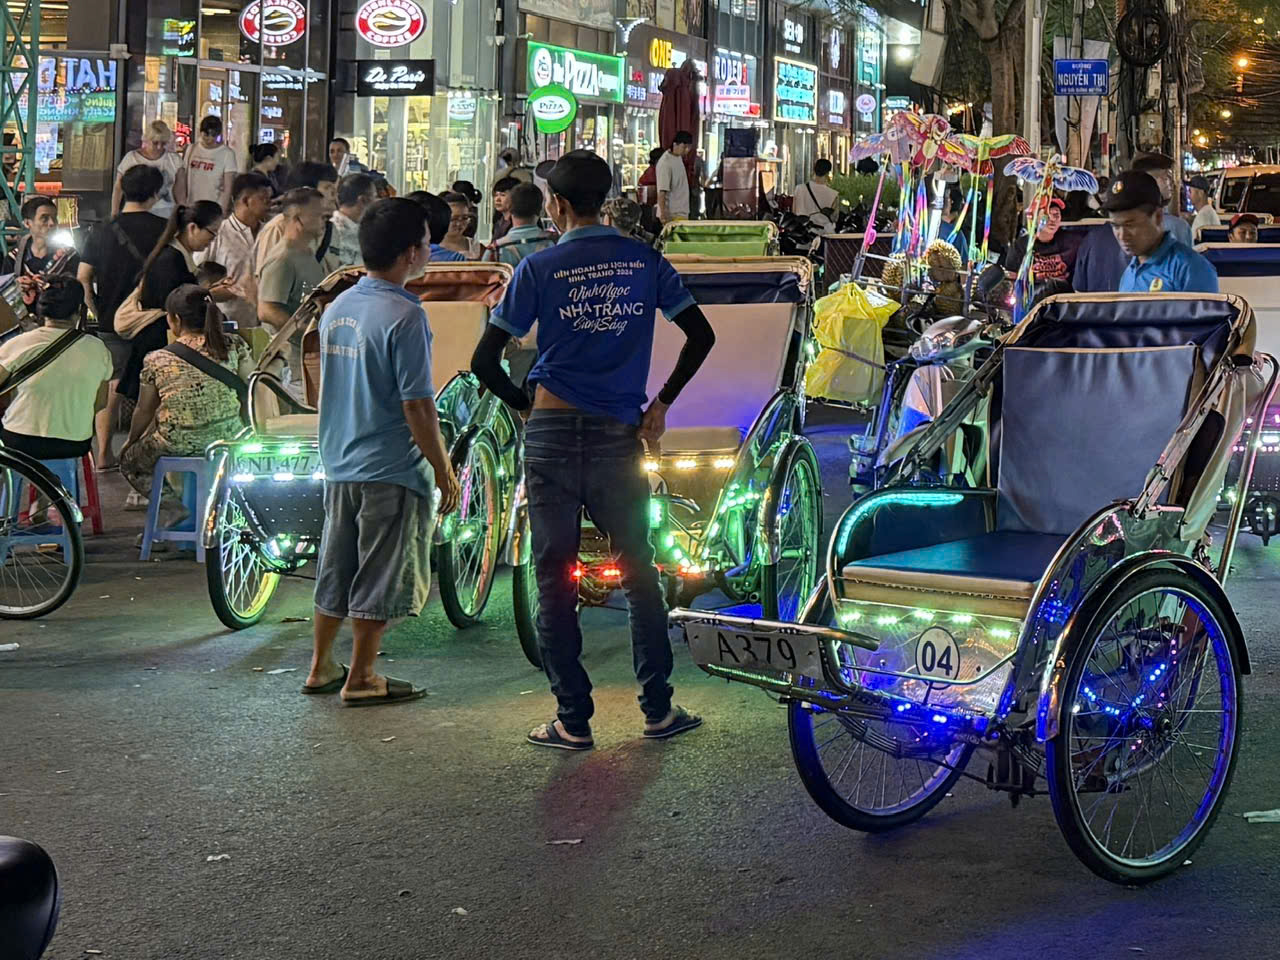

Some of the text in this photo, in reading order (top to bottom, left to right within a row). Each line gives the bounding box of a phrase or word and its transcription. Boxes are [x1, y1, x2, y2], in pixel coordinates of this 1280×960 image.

[365, 30, 414, 46] COFFEE
[365, 65, 426, 83] De Paris
[564, 51, 600, 96] PIZZA
[540, 101, 564, 110] PIZZA
[571, 264, 596, 276] HOAN
[597, 262, 609, 271] DU
[568, 274, 586, 283] NHA
[558, 301, 645, 320] NHA TRANG
[717, 631, 798, 670] A379
[921, 640, 953, 677] 04
